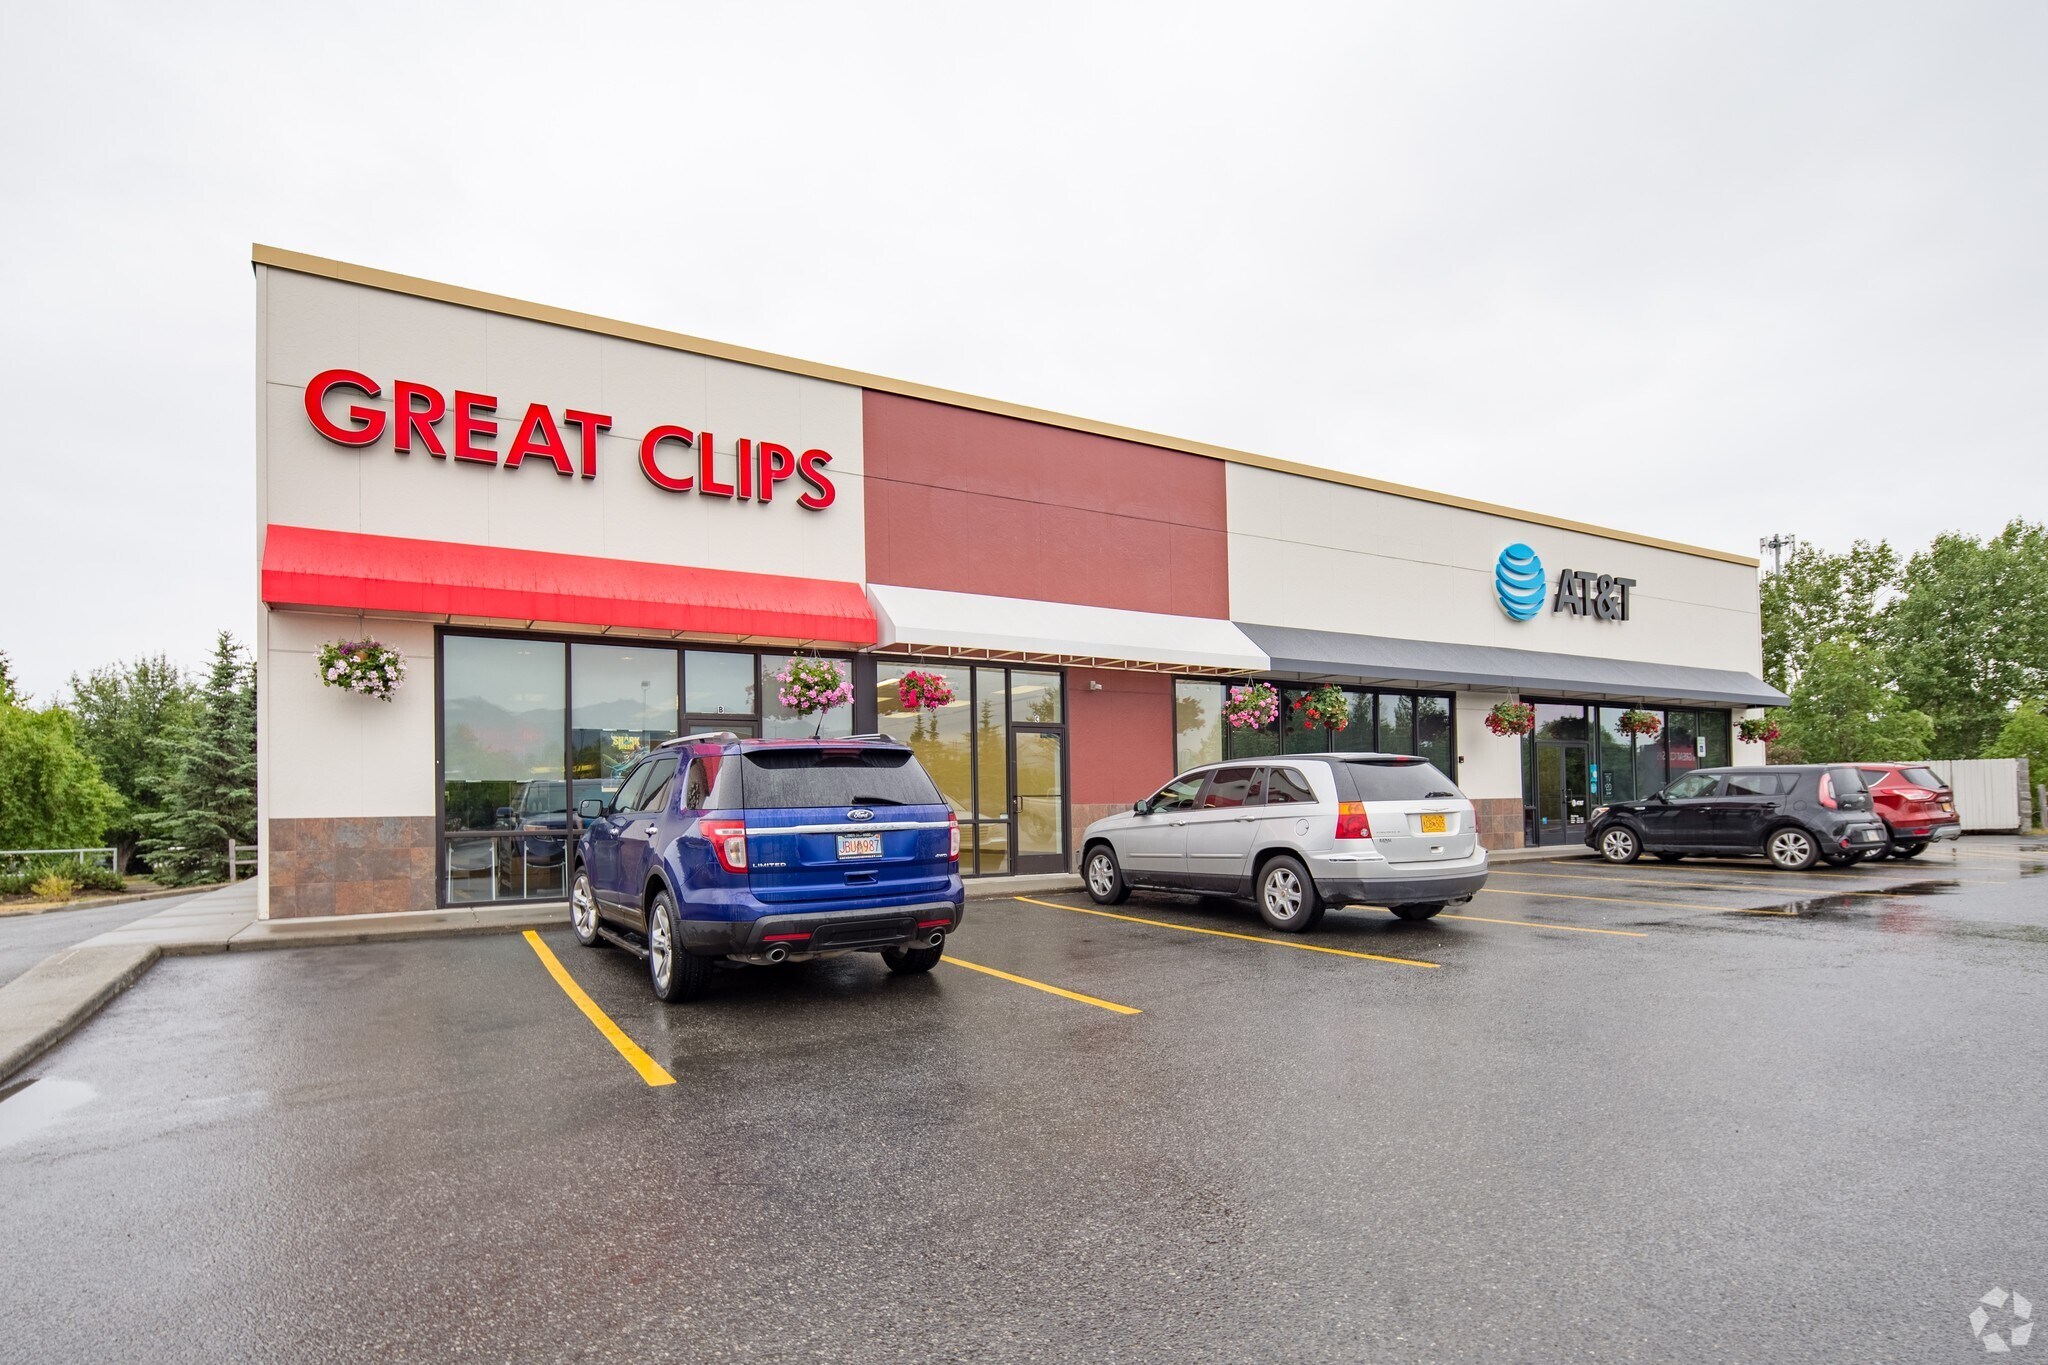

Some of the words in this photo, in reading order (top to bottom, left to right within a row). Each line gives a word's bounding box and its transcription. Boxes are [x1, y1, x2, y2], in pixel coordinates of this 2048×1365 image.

[304, 368, 613, 480] GREAT
[638, 424, 836, 512] CLIPS
[1554, 568, 1637, 622] AT&T
[611, 735, 640, 746] SHARK
[853, 811, 869, 819] Ford
[862, 839, 880, 852] 987
